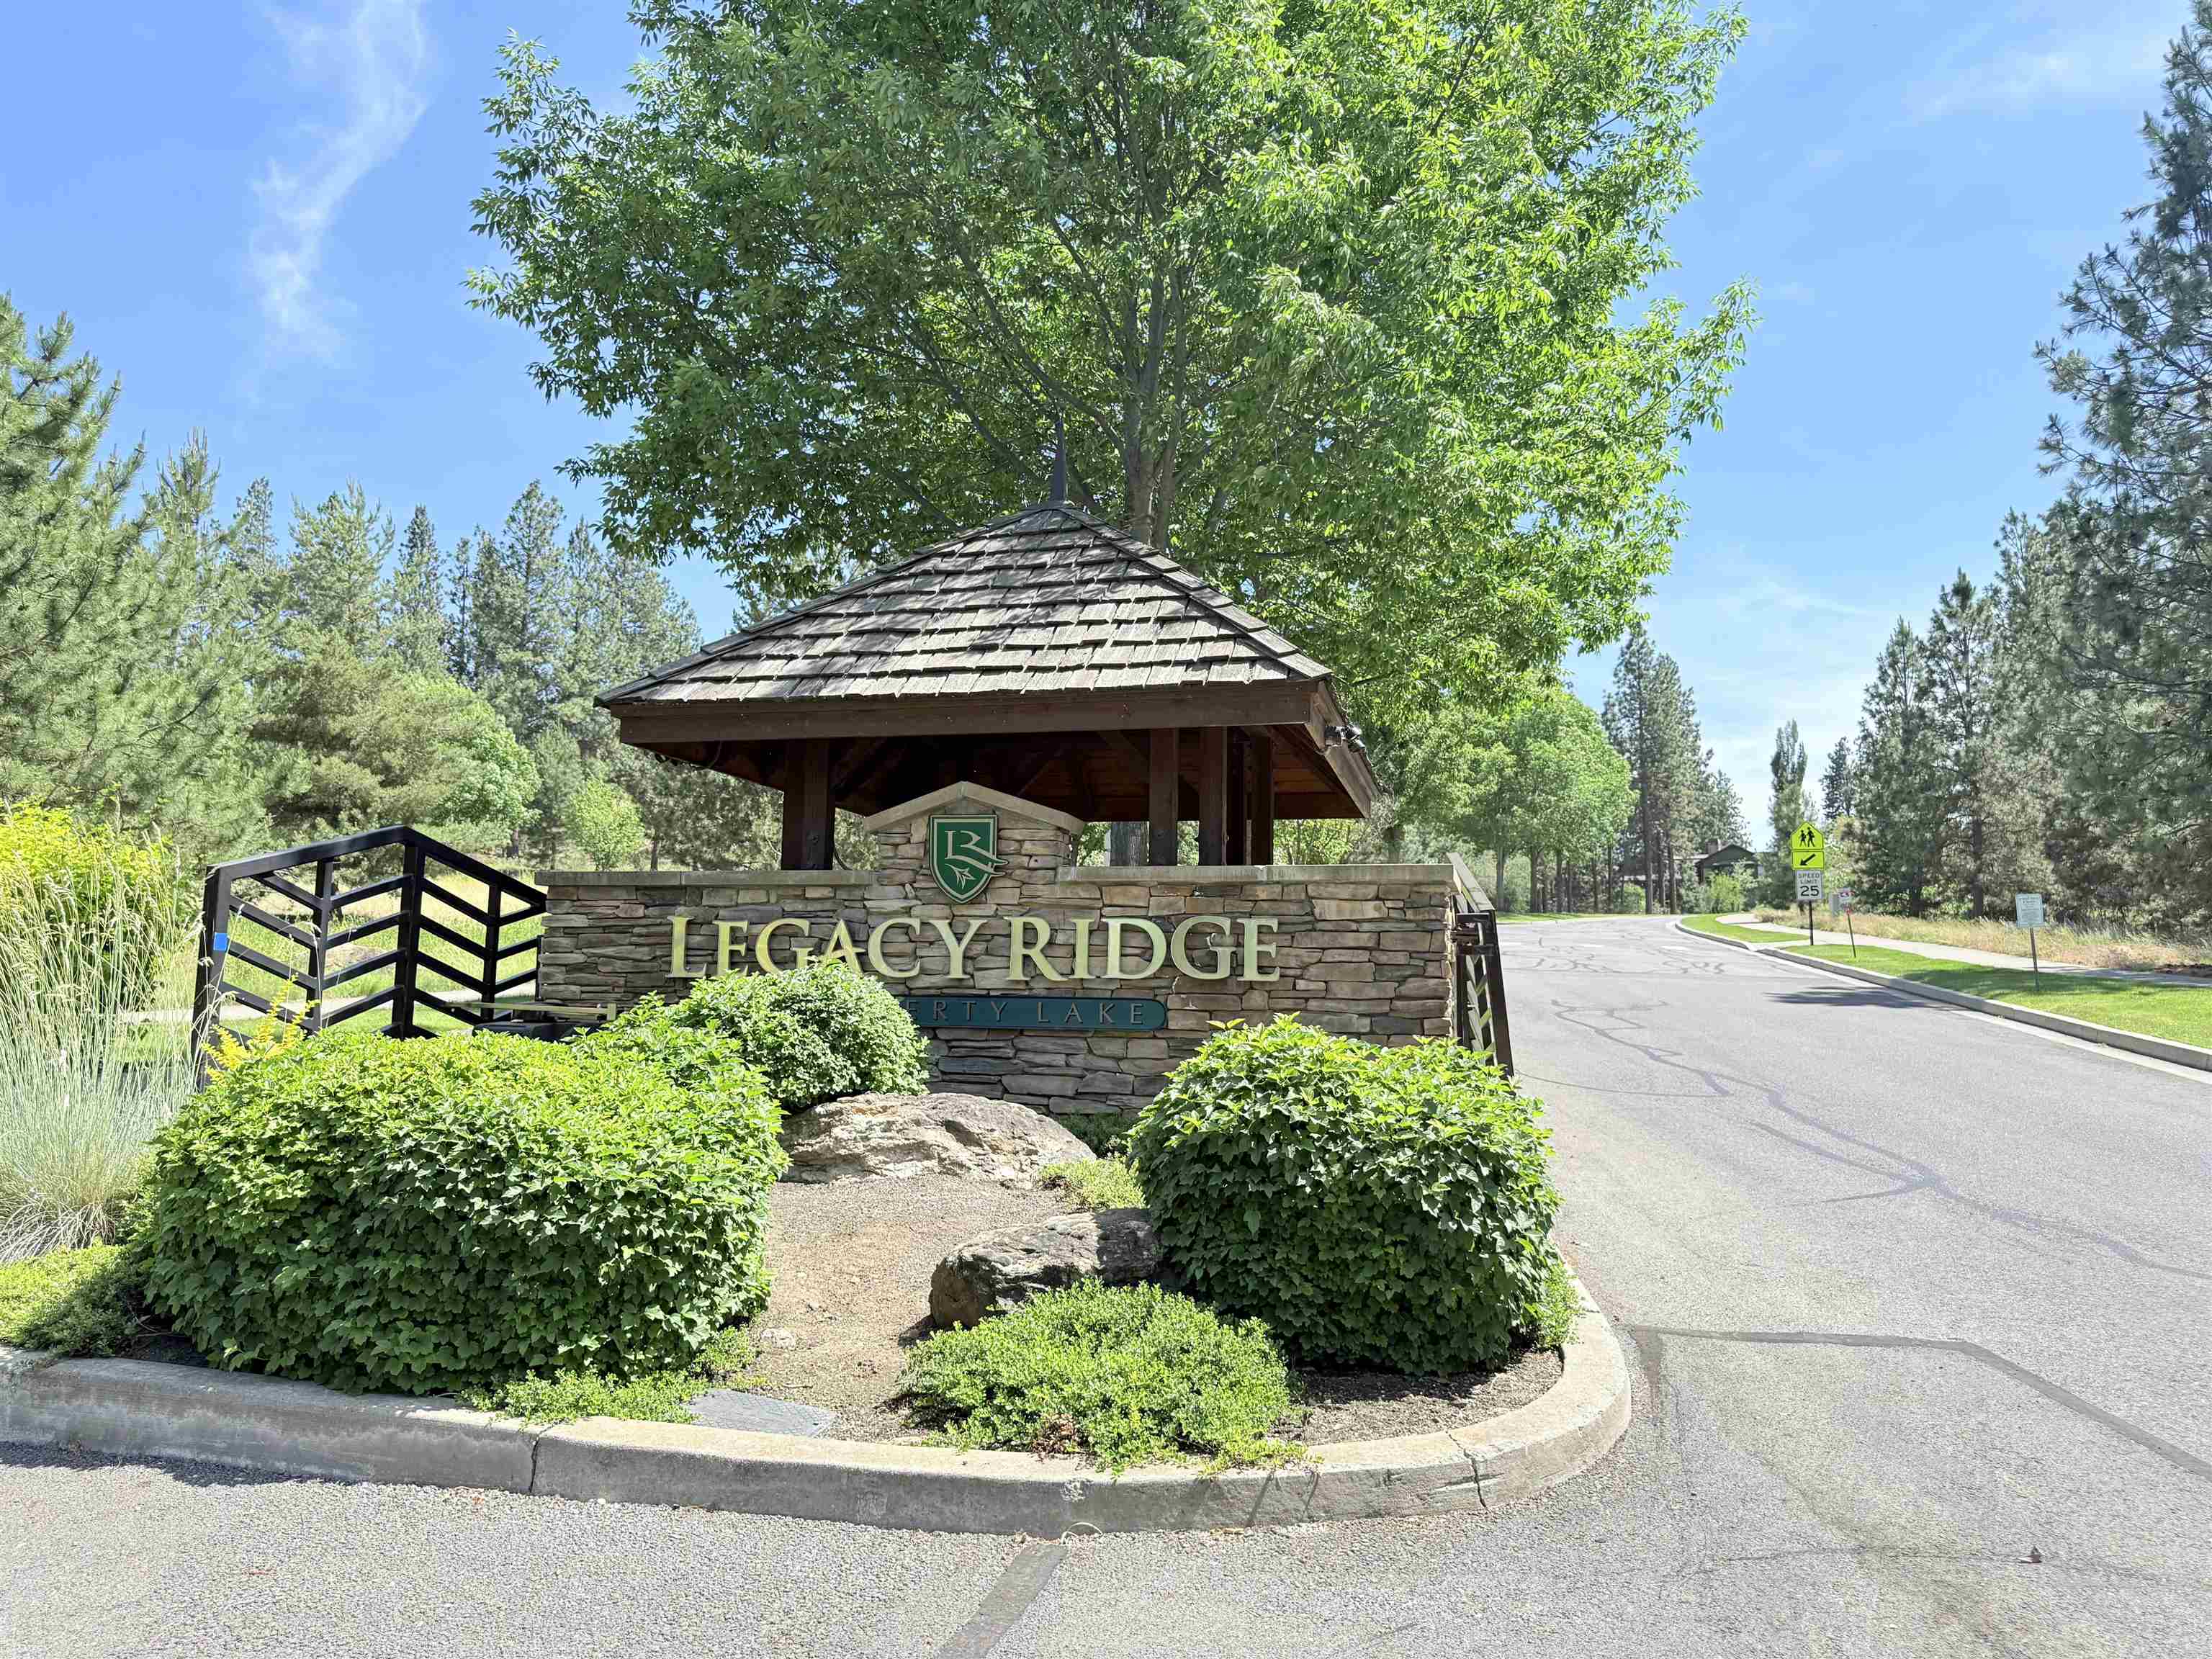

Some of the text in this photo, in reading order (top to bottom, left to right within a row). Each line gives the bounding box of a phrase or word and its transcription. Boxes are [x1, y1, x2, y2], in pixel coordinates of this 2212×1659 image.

[1800, 886, 1820, 896] 25
[665, 915, 1281, 981] LEGACY RIDGE
[905, 999, 1146, 1025] ERTY LAKE
